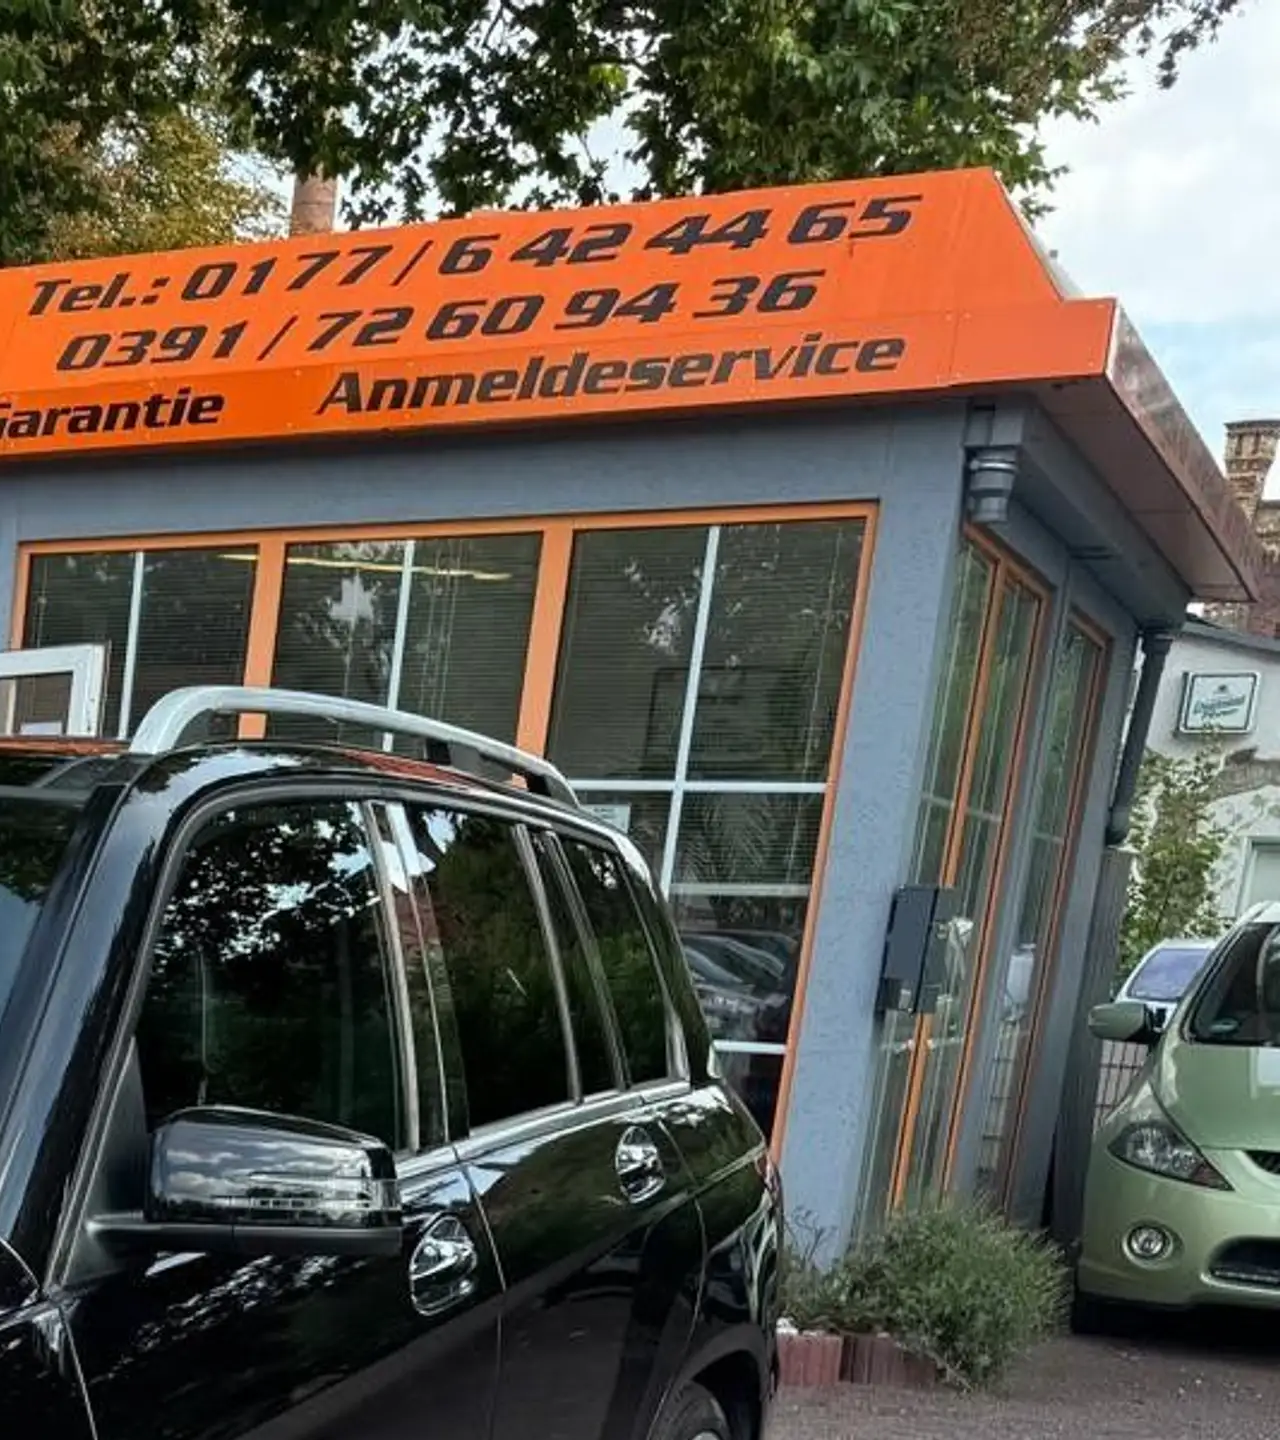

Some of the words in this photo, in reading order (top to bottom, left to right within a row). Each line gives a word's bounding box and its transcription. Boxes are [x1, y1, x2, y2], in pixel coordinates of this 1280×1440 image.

[28, 273, 170, 316] Tel.:
[644, 208, 773, 256] 44
[787, 195, 923, 245] 65
[425, 295, 544, 340] 60
[554, 282, 680, 330] 94
[693, 269, 826, 318] 36
[316, 333, 907, 416] Anmeldeservice
